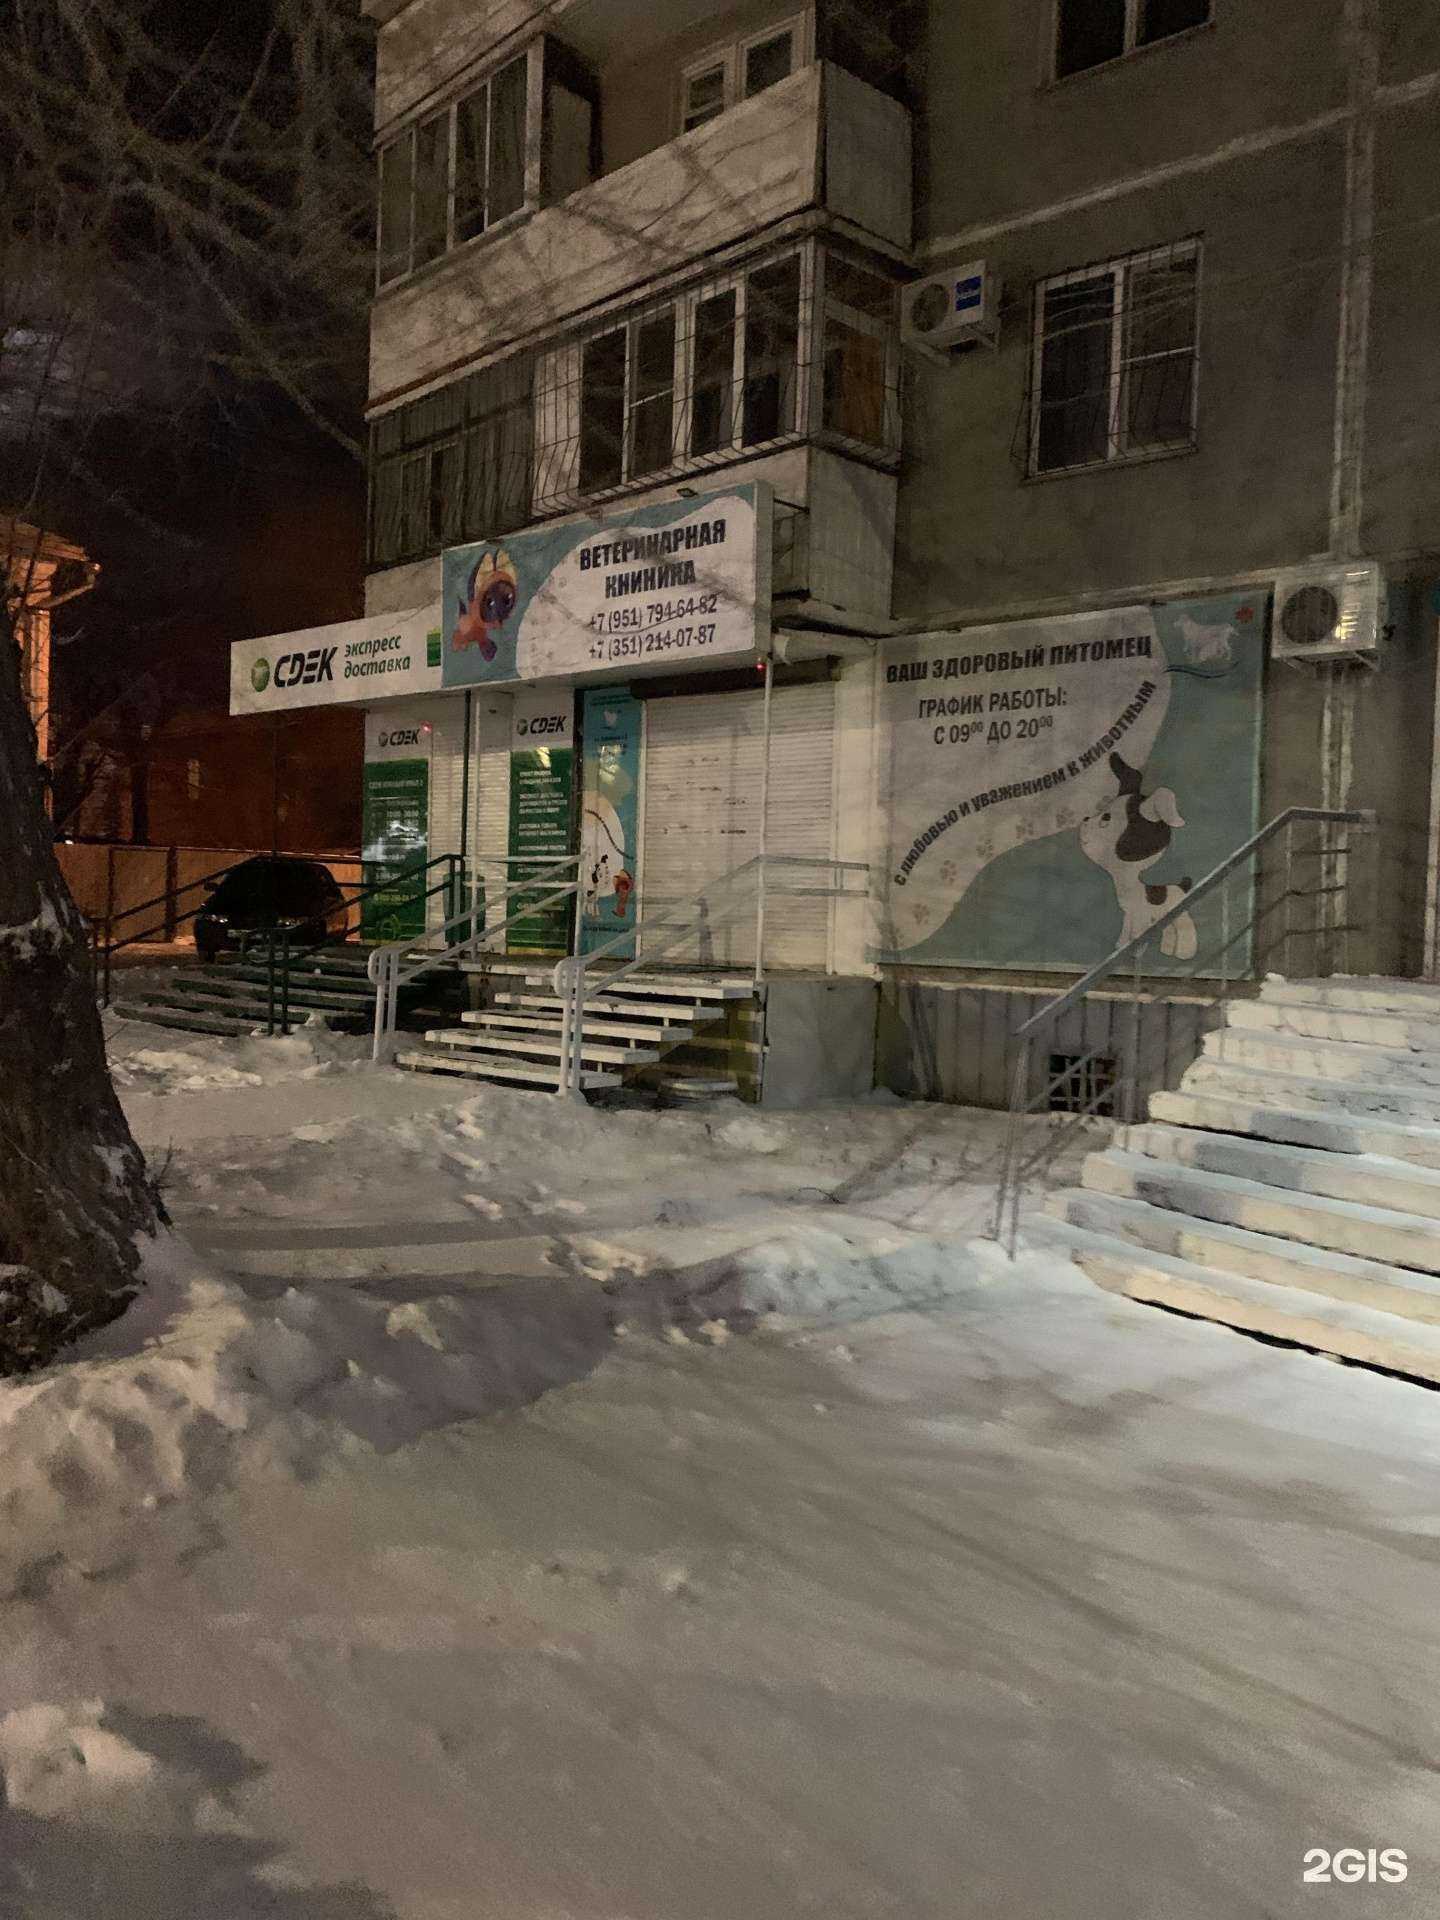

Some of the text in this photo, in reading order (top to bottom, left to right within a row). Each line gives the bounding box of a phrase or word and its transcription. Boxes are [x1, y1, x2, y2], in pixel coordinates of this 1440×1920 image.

[580, 519, 726, 571] ВЕТЕРИНАРНАЯ
[590, 594, 718, 633] +7 (951) 794-64-82
[344, 635, 402, 658] экспресс
[590, 624, 716, 660] +7 (351) 214-07-87
[274, 647, 338, 688] CDEK
[344, 656, 411, 679] доставка
[886, 636, 1153, 683] ВАШ ЗДОРОВЫЙ ПИТОМЕЦ
[918, 686, 1067, 719] ГРАФИК РАБОТЫ:
[389, 729, 420, 746] CDEK
[530, 716, 567, 734] CDEK
[933, 726, 945, 745] С
[987, 721, 1011, 745] ДО
